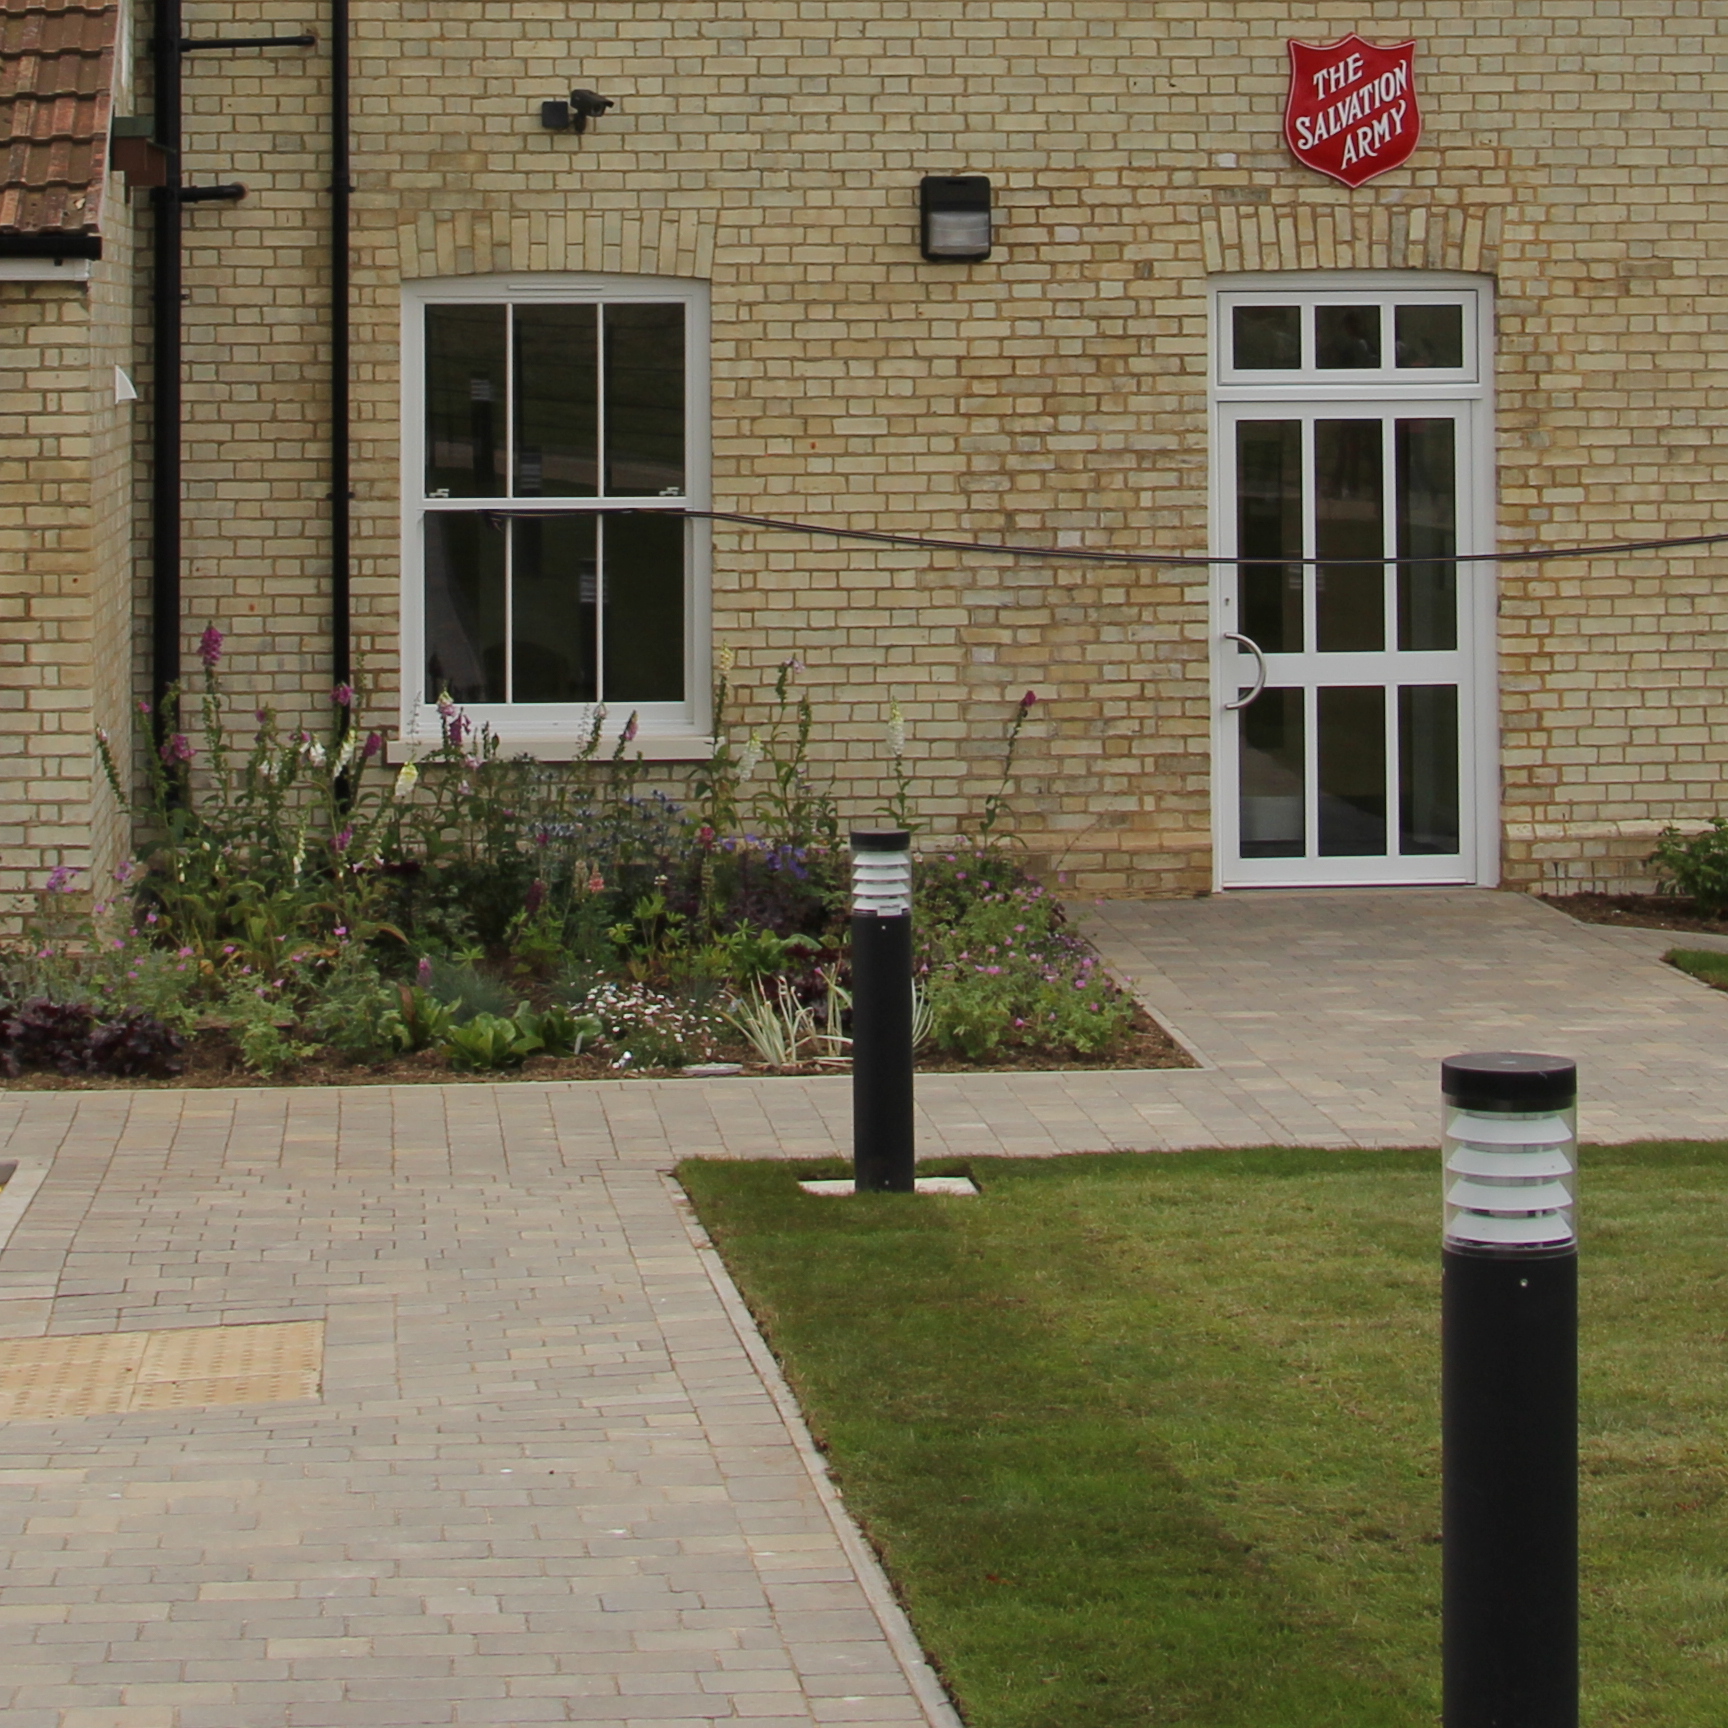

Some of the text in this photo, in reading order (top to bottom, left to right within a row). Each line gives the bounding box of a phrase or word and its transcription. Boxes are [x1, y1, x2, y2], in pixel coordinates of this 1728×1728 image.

[1295, 59, 1407, 150] SALVATION
[1313, 53, 1364, 101] THE
[1340, 99, 1406, 171] ARMY
